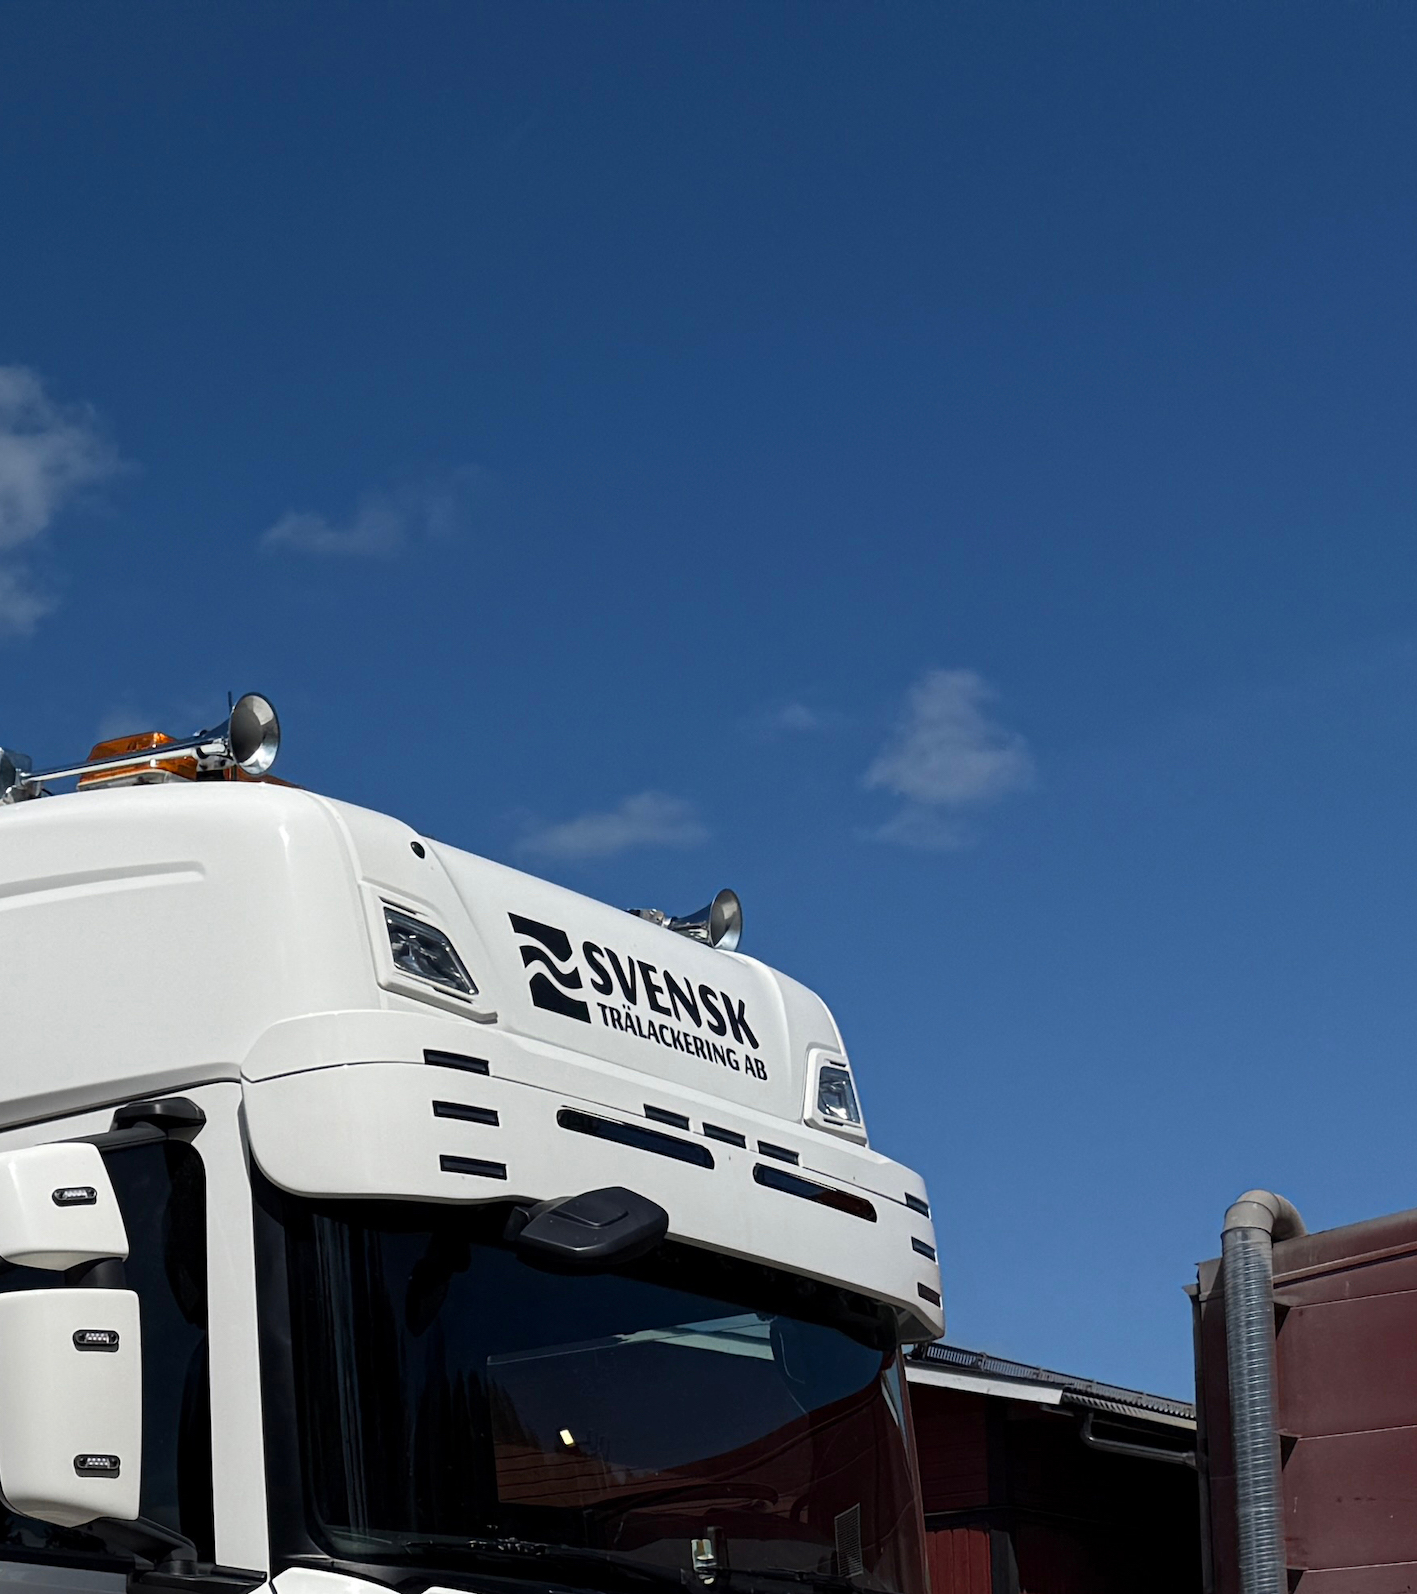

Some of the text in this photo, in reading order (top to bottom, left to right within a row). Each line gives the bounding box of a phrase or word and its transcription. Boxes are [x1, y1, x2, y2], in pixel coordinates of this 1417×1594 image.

[582, 940, 760, 1050] SVENSK
[596, 1002, 768, 1081] TRÄLACKERING AB
